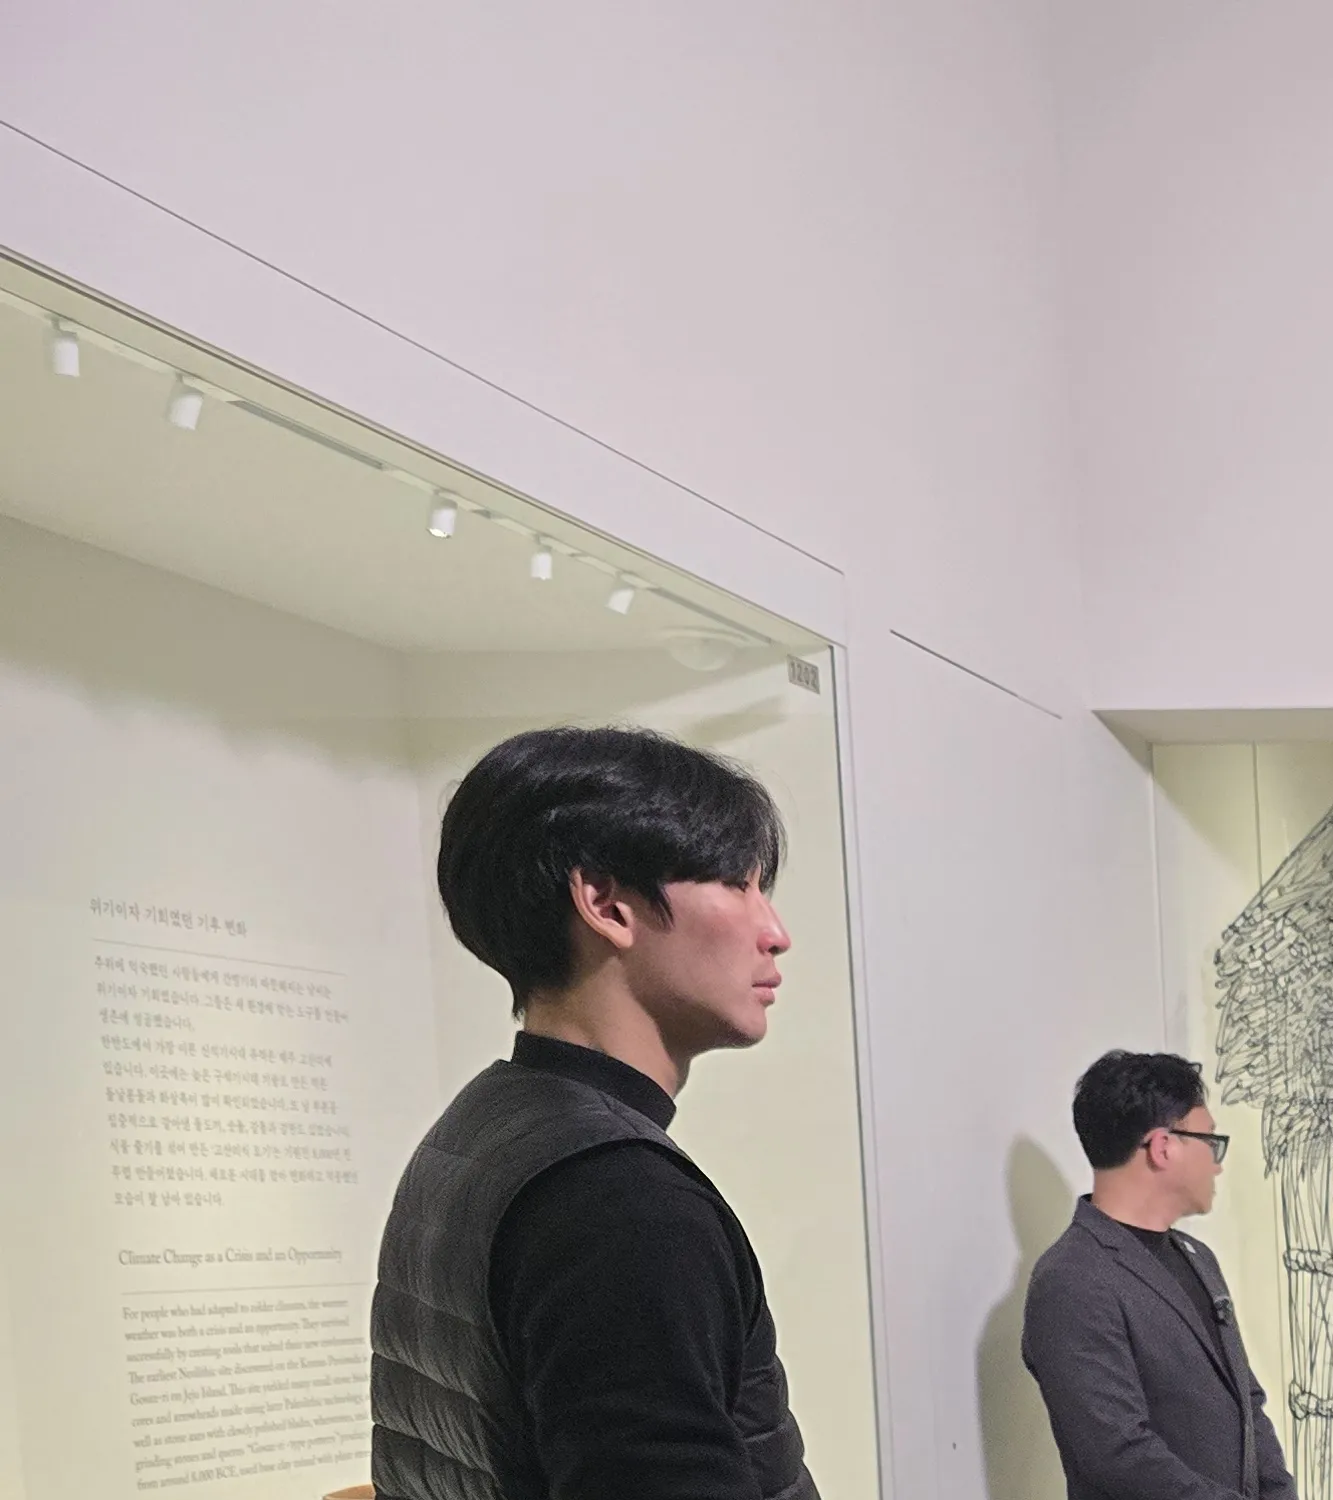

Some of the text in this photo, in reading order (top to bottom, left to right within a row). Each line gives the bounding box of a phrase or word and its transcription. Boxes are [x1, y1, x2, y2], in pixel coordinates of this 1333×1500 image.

[90, 895, 140, 922] 위기이자
[145, 903, 194, 930] 기회였던
[197, 912, 222, 934] 기후
[118, 1246, 341, 1269] Climate Change as a Crisis and an Opportunity
